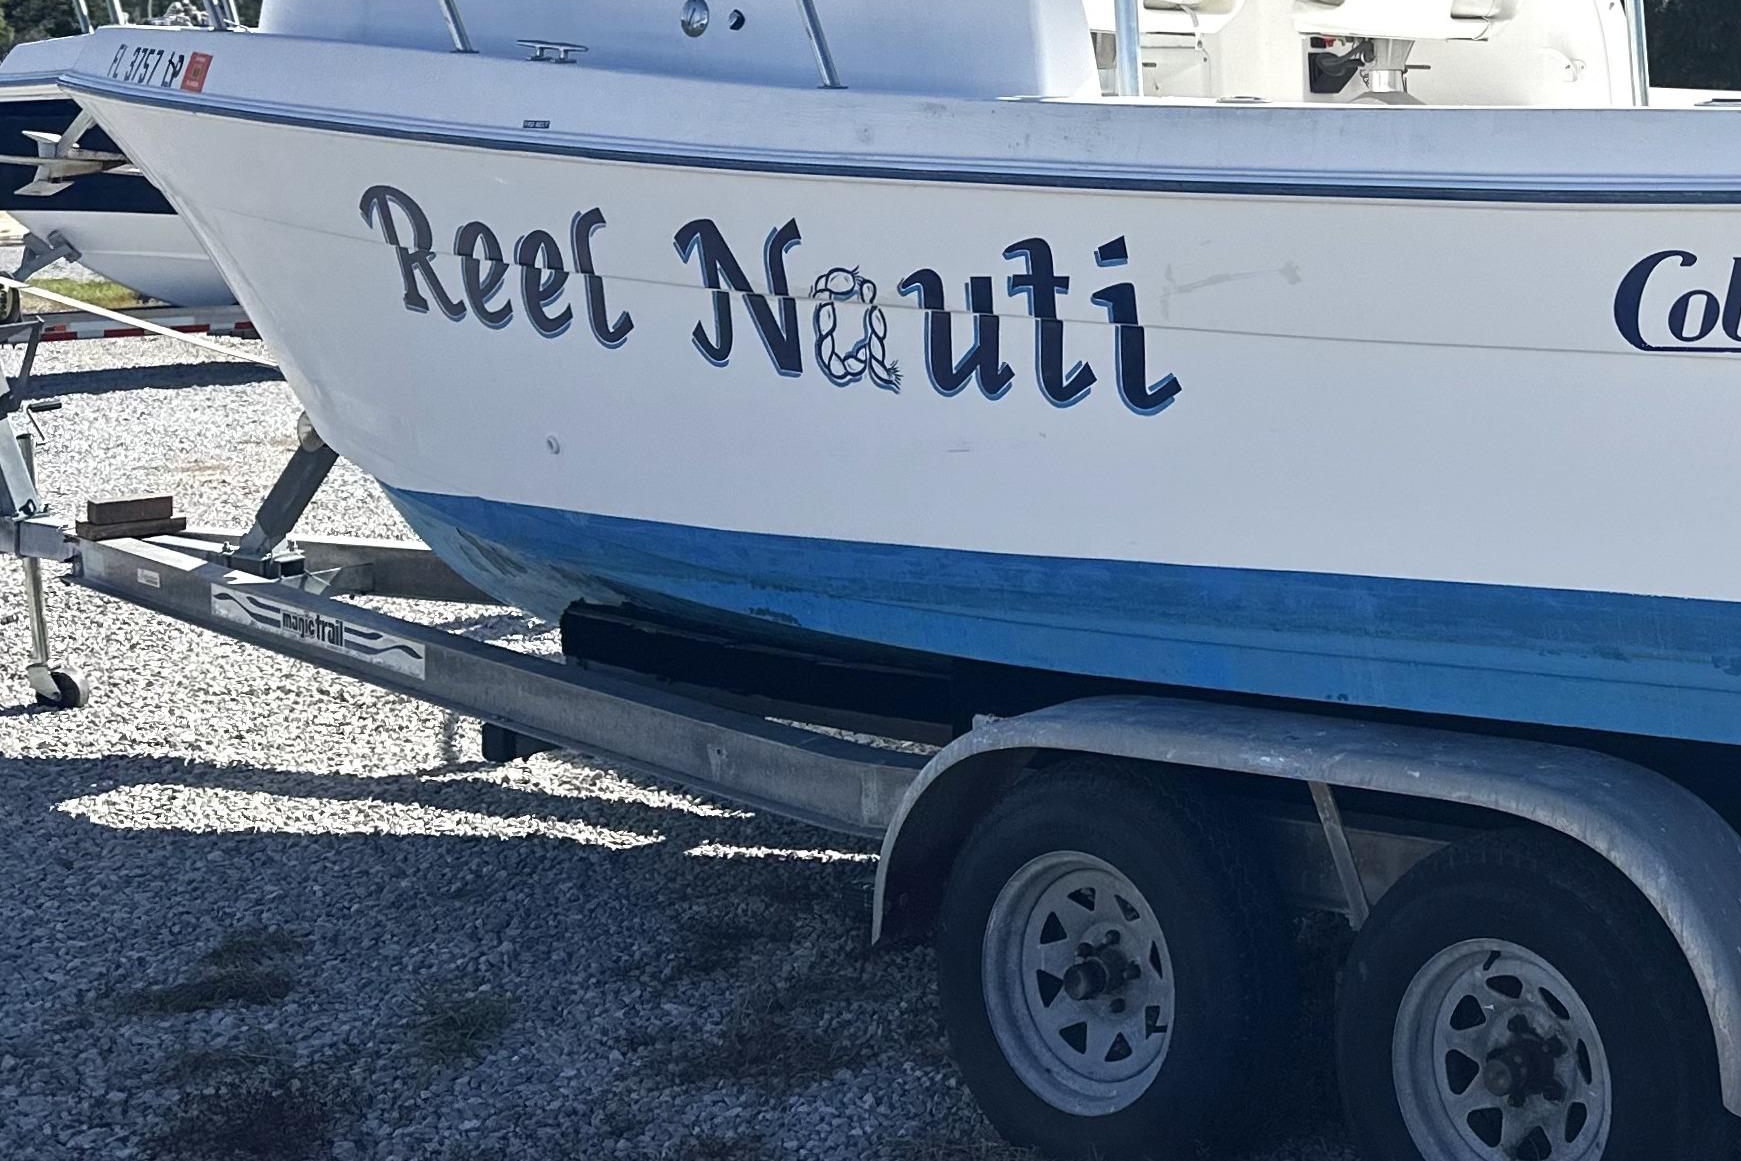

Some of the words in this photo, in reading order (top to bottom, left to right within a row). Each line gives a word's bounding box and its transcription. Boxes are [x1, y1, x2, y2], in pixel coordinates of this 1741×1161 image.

[107, 44, 127, 79] FL
[124, 47, 164, 85] 3757
[359, 185, 634, 349] Reel
[673, 217, 1182, 416] Nauti
